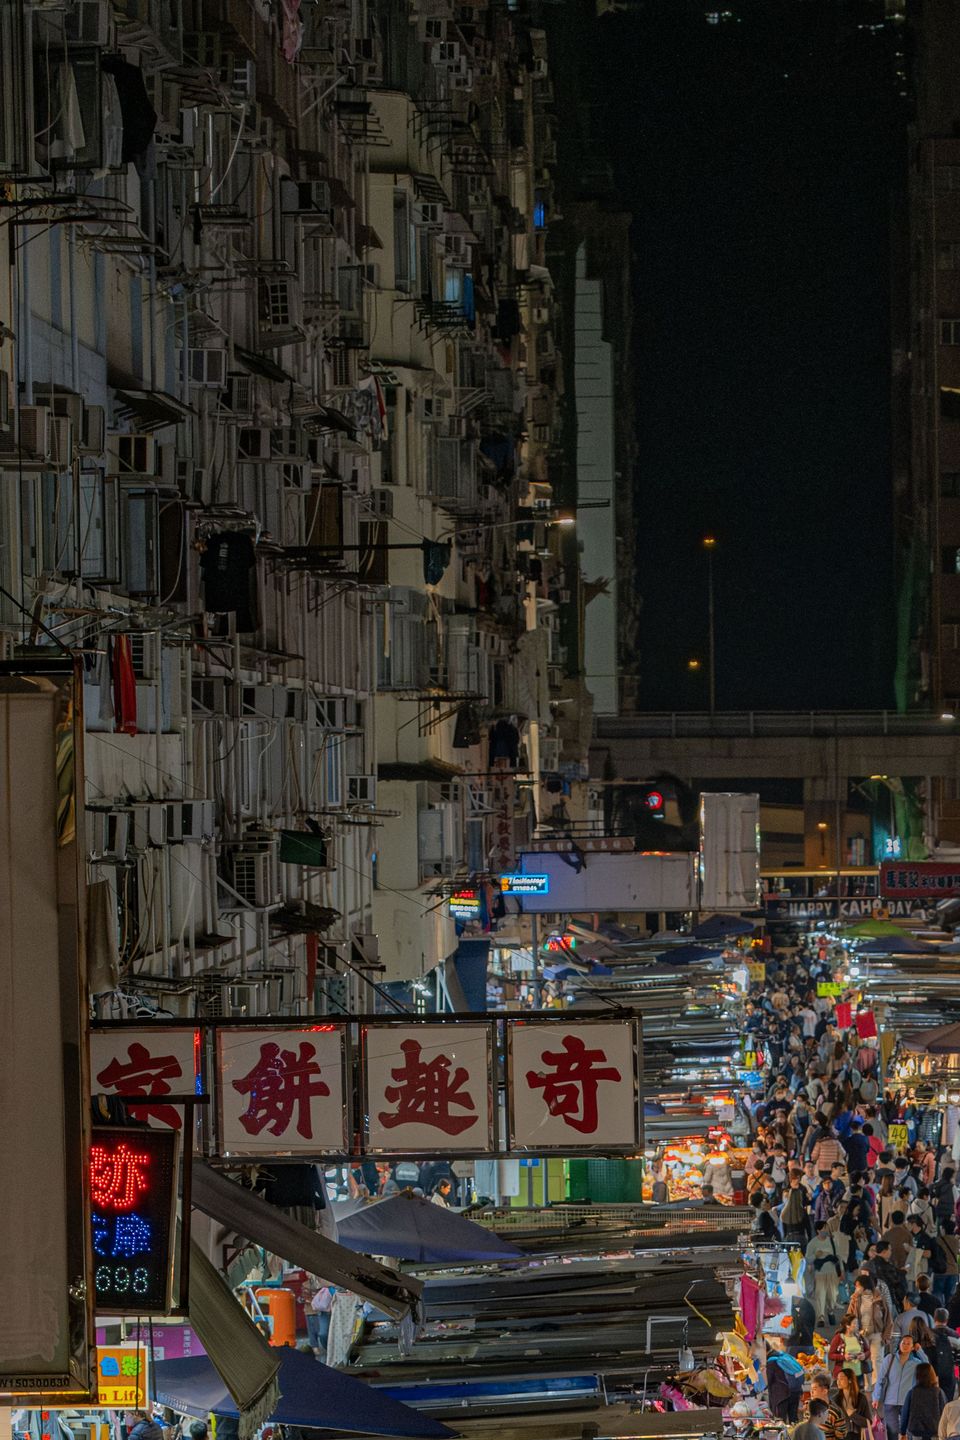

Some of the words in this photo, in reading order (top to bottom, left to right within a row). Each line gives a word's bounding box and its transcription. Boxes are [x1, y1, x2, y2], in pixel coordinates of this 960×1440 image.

[789, 902, 832, 916] HAPPY
[887, 900, 913, 915] DAY
[891, 1127, 907, 1140] 40
